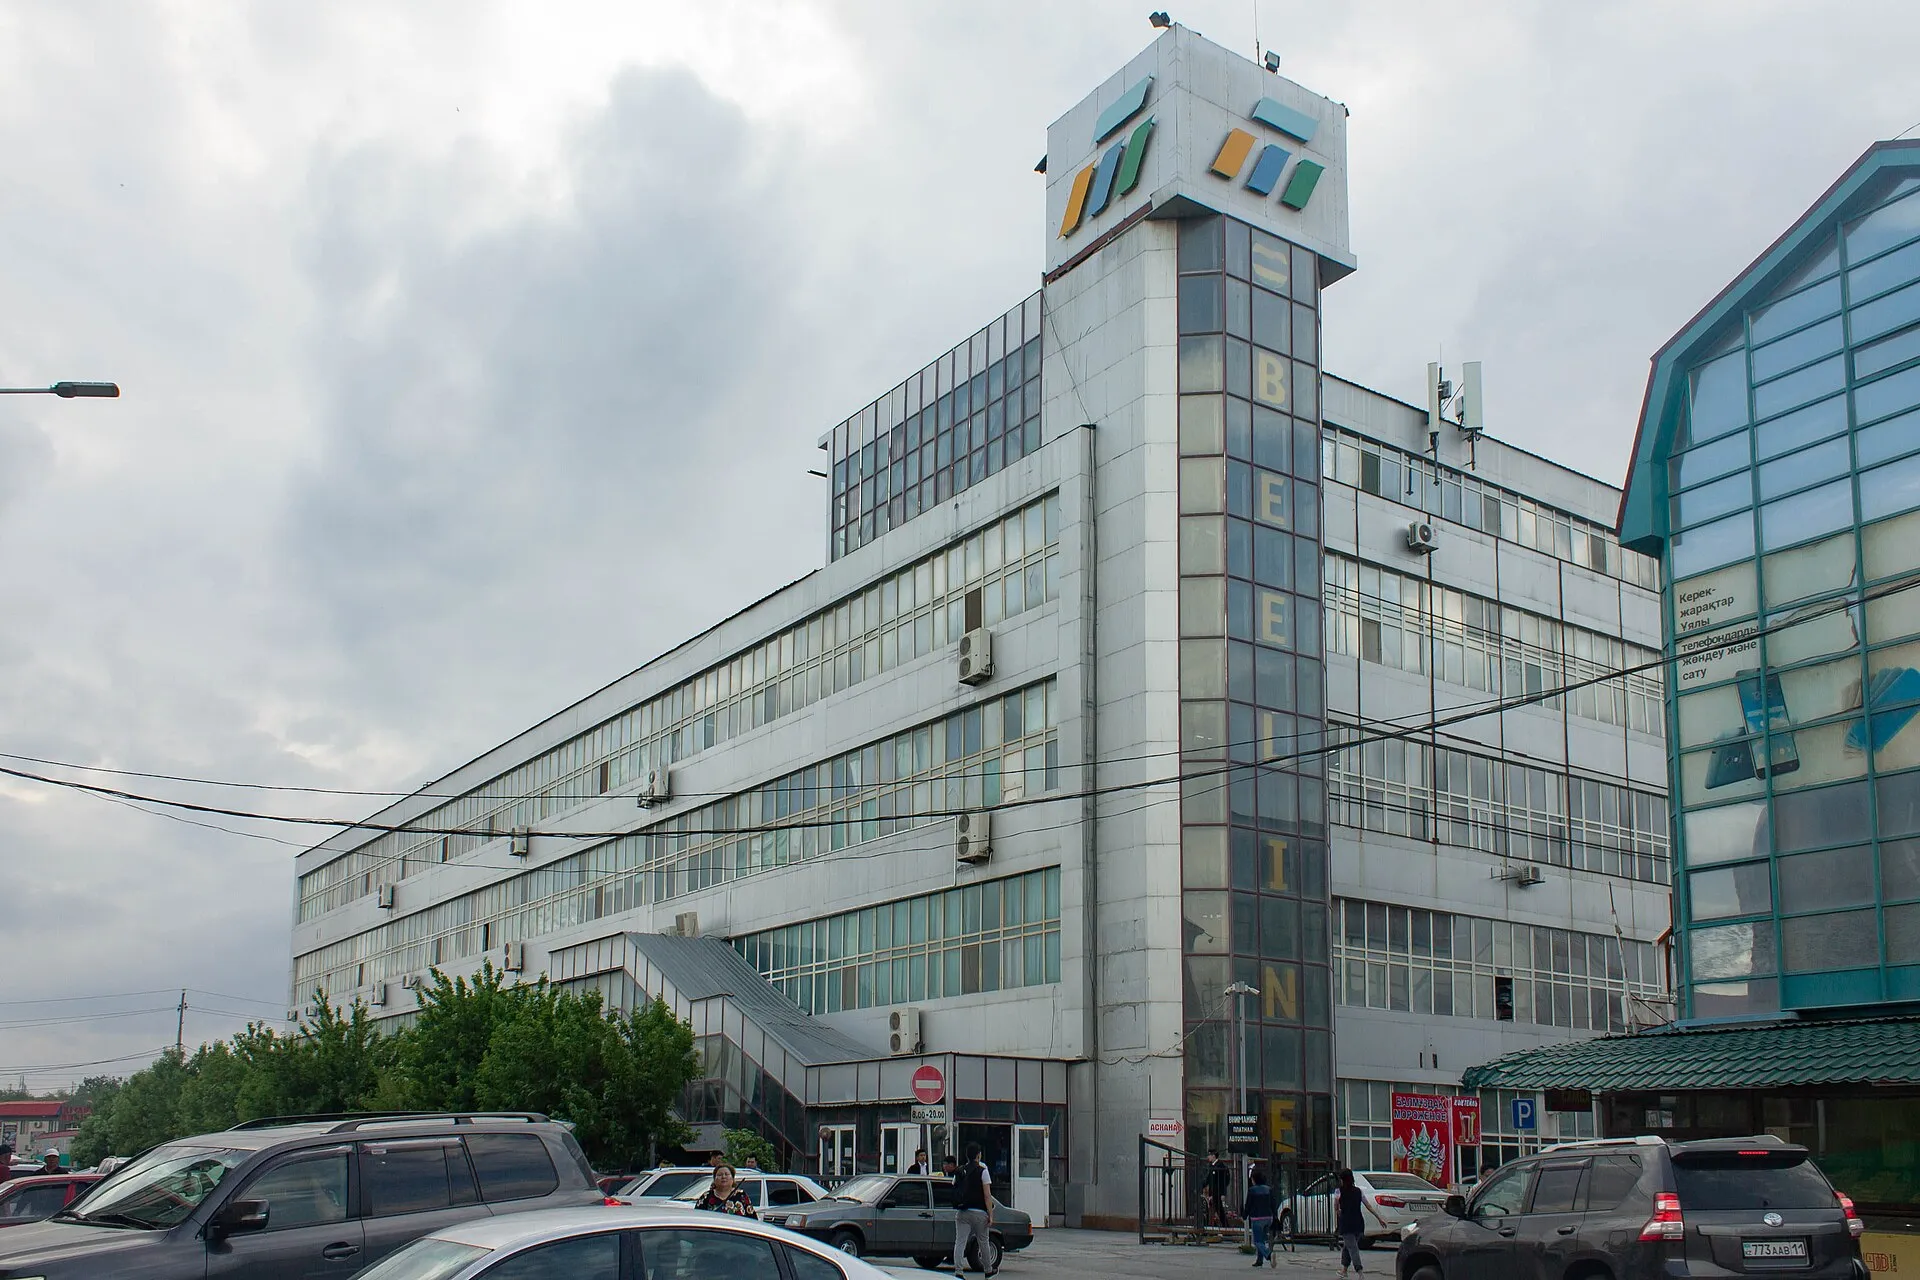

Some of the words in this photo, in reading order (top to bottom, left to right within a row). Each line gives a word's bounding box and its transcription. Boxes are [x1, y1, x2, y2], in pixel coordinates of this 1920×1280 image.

[1680, 587, 1716, 604] Керек-
[1680, 596, 1735, 618] жарақтар
[1682, 649, 1725, 667] жөндеу
[1727, 641, 1757, 656] және
[1682, 668, 1707, 681] сату
[1257, 351, 1297, 1153] BEELINE
[1393, 1109, 1448, 1122] МОРОЖЕНОЕ
[1518, 1101, 1531, 1128] P
